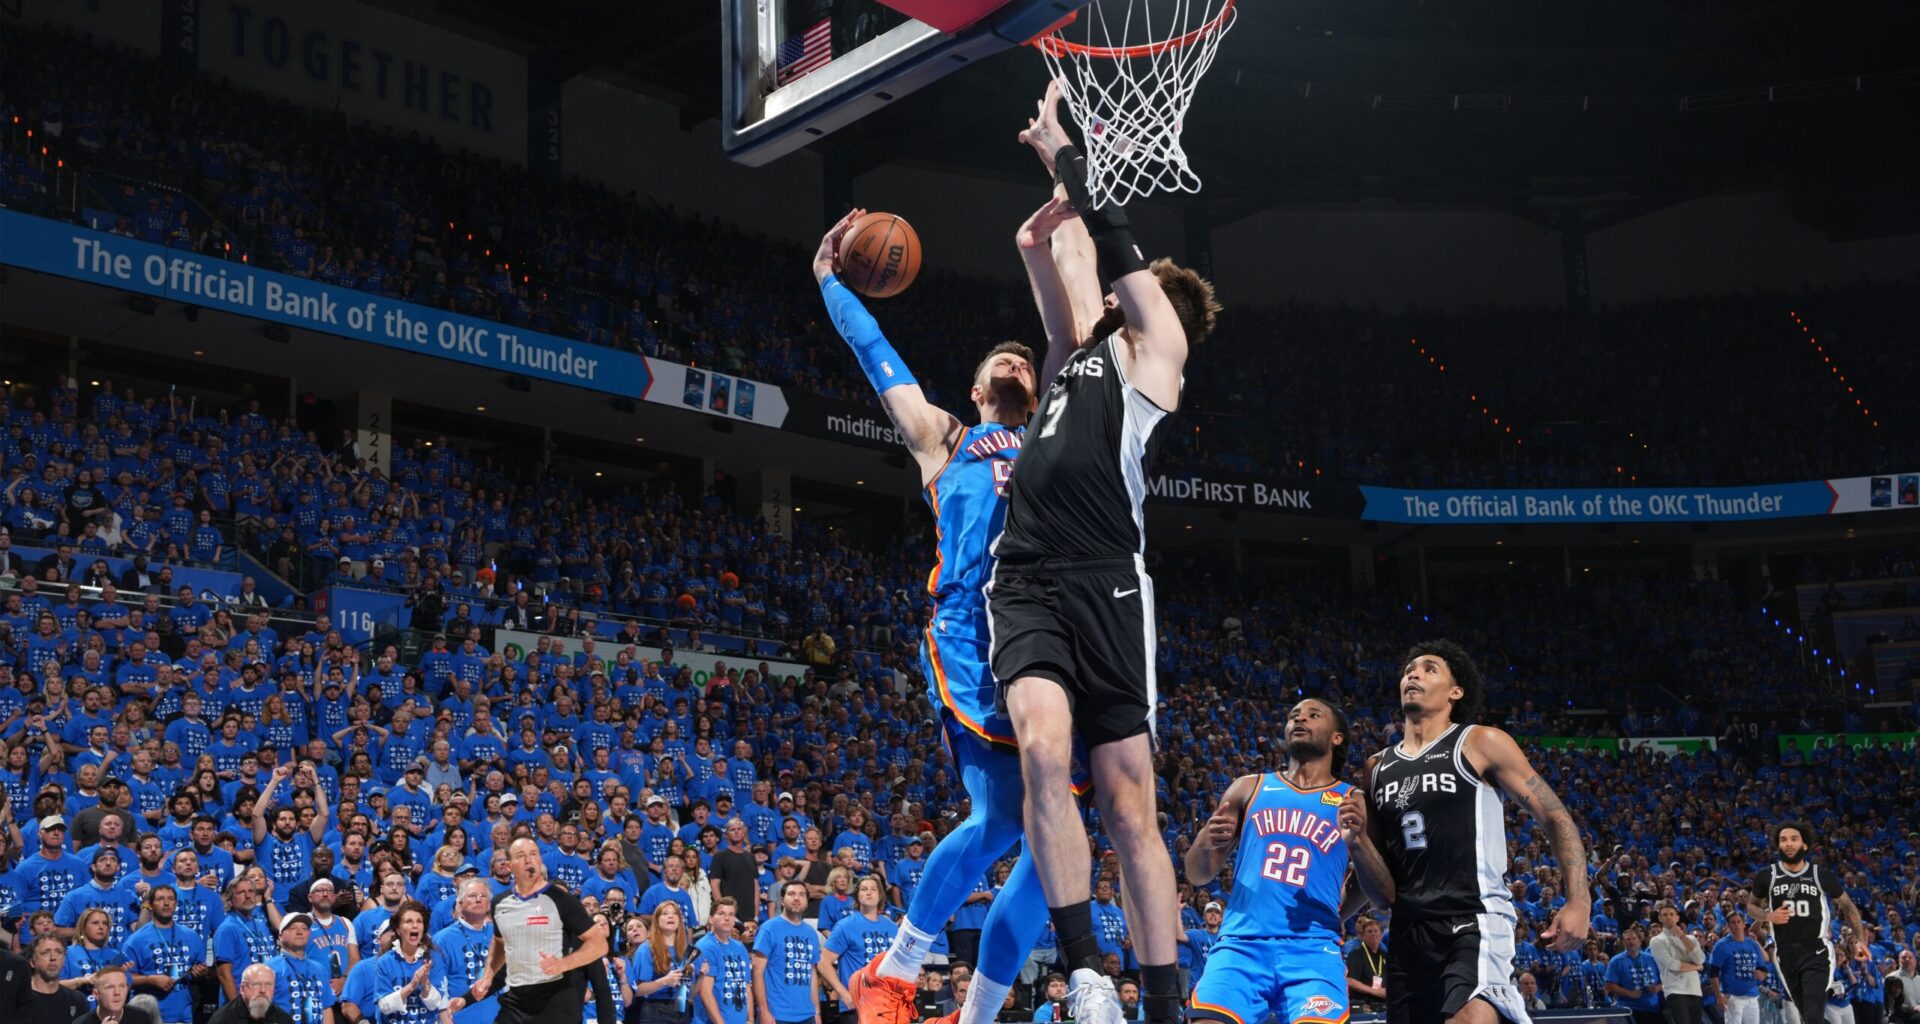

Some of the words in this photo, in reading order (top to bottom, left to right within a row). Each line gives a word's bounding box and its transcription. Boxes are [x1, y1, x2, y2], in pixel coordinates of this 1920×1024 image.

[228, 4, 496, 133] TOGETHER
[547, 111, 560, 161] 325
[73, 237, 131, 279] The
[143, 254, 255, 307] Official
[265, 282, 338, 325] Bank
[347, 302, 377, 333] of
[384, 309, 429, 345] the
[437, 320, 489, 358] OKC
[497, 333, 599, 381] Thunder
[1039, 394, 1069, 439] 7
[369, 413, 380, 464] 224
[967, 430, 1026, 460] THUN
[1403, 497, 1440, 517] The
[1446, 494, 1518, 517] Official
[1525, 495, 1576, 516] Bank
[1582, 493, 1602, 516] of
[1608, 493, 1642, 515] the
[1649, 494, 1689, 515] OKC
[1695, 490, 1783, 514] Thunder
[339, 609, 372, 631] 116
[1375, 773, 1456, 810] SPURS
[1251, 808, 1342, 854] THUNDER
[1400, 811, 1428, 848] 2
[274, 844, 300, 854] OUR
[274, 851, 302, 861] CITY
[1262, 841, 1311, 888] 22
[40, 873, 74, 883] OUR
[558, 873, 583, 881] CITY
[41, 882, 75, 892] CITY
[1773, 883, 1818, 899] SPURS
[172, 913, 206, 921] CITY
[153, 945, 190, 955] OUR
[786, 942, 813, 950] OUR
[866, 946, 888, 954] CIT
[155, 956, 190, 964] CITY
[786, 951, 813, 960] CITY
[786, 961, 812, 970] LOUD
